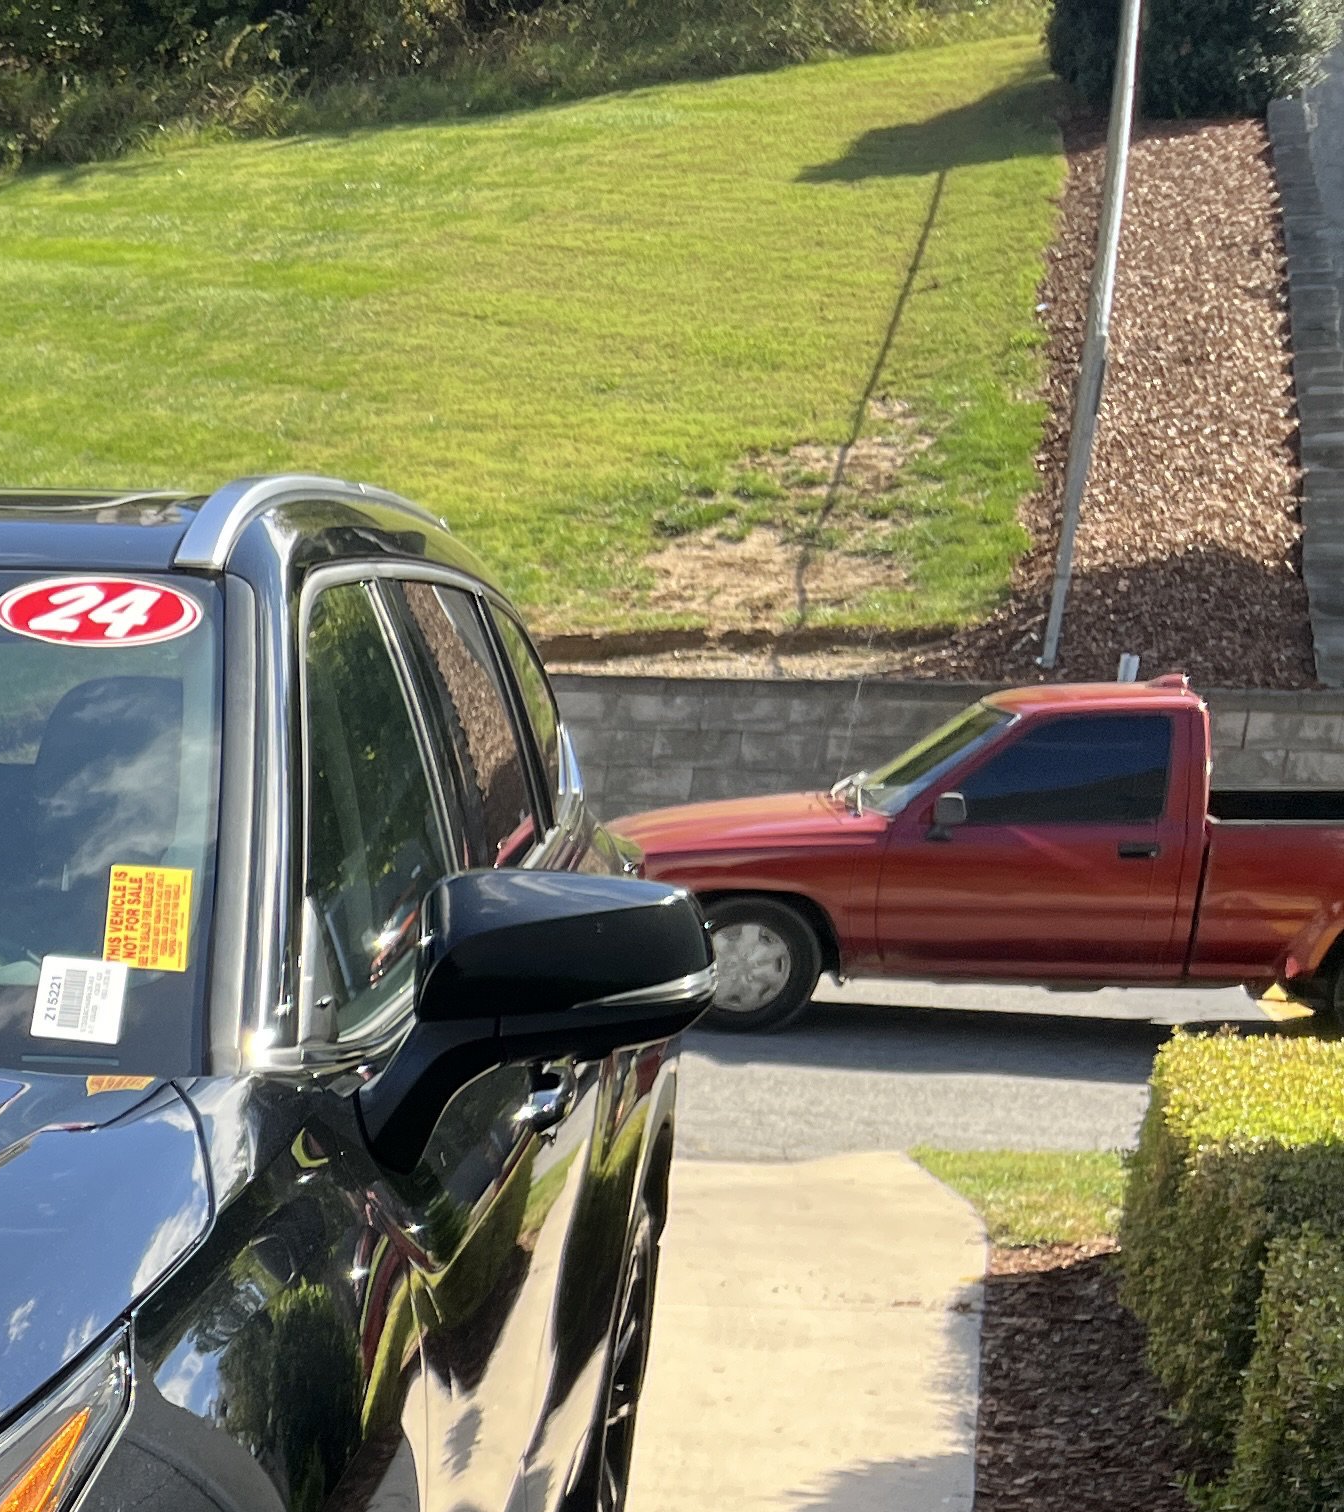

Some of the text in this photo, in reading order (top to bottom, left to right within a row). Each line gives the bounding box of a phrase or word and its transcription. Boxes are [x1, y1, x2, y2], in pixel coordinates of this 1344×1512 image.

[27, 584, 162, 639] 24
[114, 871, 128, 881] IS
[109, 885, 127, 932] VEHICLE
[123, 877, 143, 959] NOT FOR SALE
[106, 936, 122, 961] THIS
[44, 975, 63, 1021] Z15221
